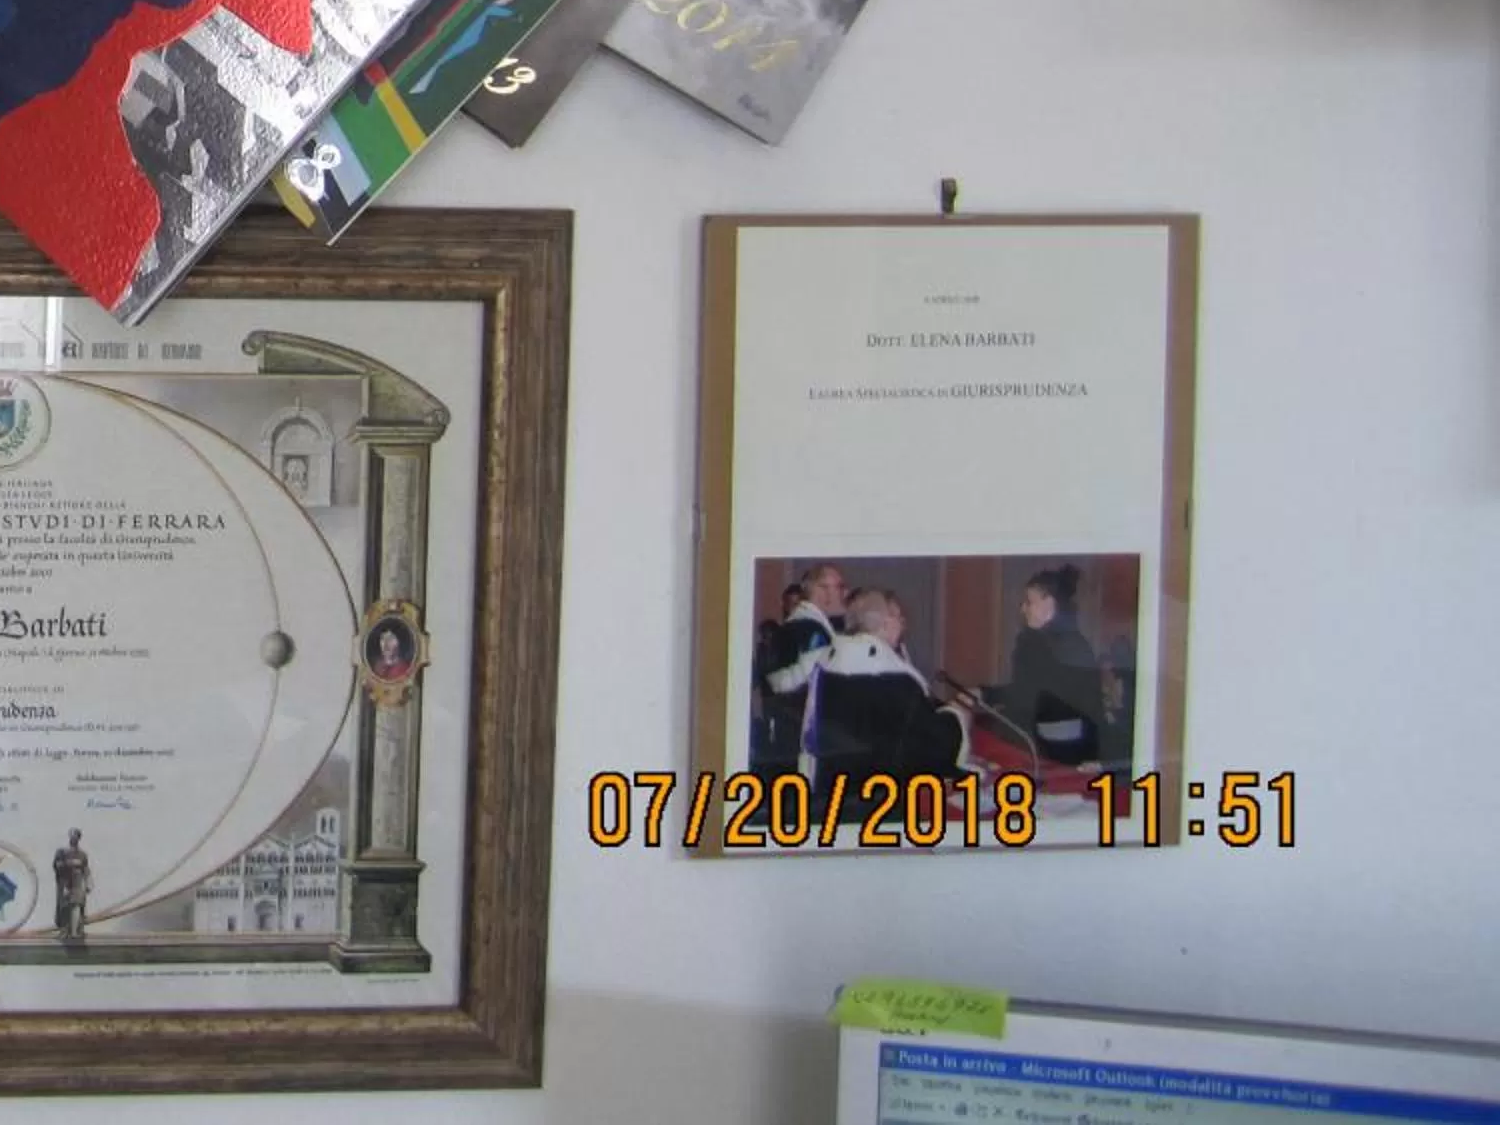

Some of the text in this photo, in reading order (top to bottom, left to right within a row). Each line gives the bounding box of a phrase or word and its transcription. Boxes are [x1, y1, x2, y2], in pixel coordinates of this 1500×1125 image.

[909, 332, 961, 348] ELENA
[964, 331, 1036, 348] BARBATI
[950, 382, 1088, 398] GIURISPRUDENZA
[81, 513, 106, 530] DI
[117, 513, 227, 530] FERRARA
[898, 1049, 939, 1068] Posta
[943, 1053, 958, 1070] in
[962, 1056, 1007, 1074] arrivo
[1021, 1060, 1092, 1083] Microsoft
[1095, 1066, 1156, 1089] Outlook
